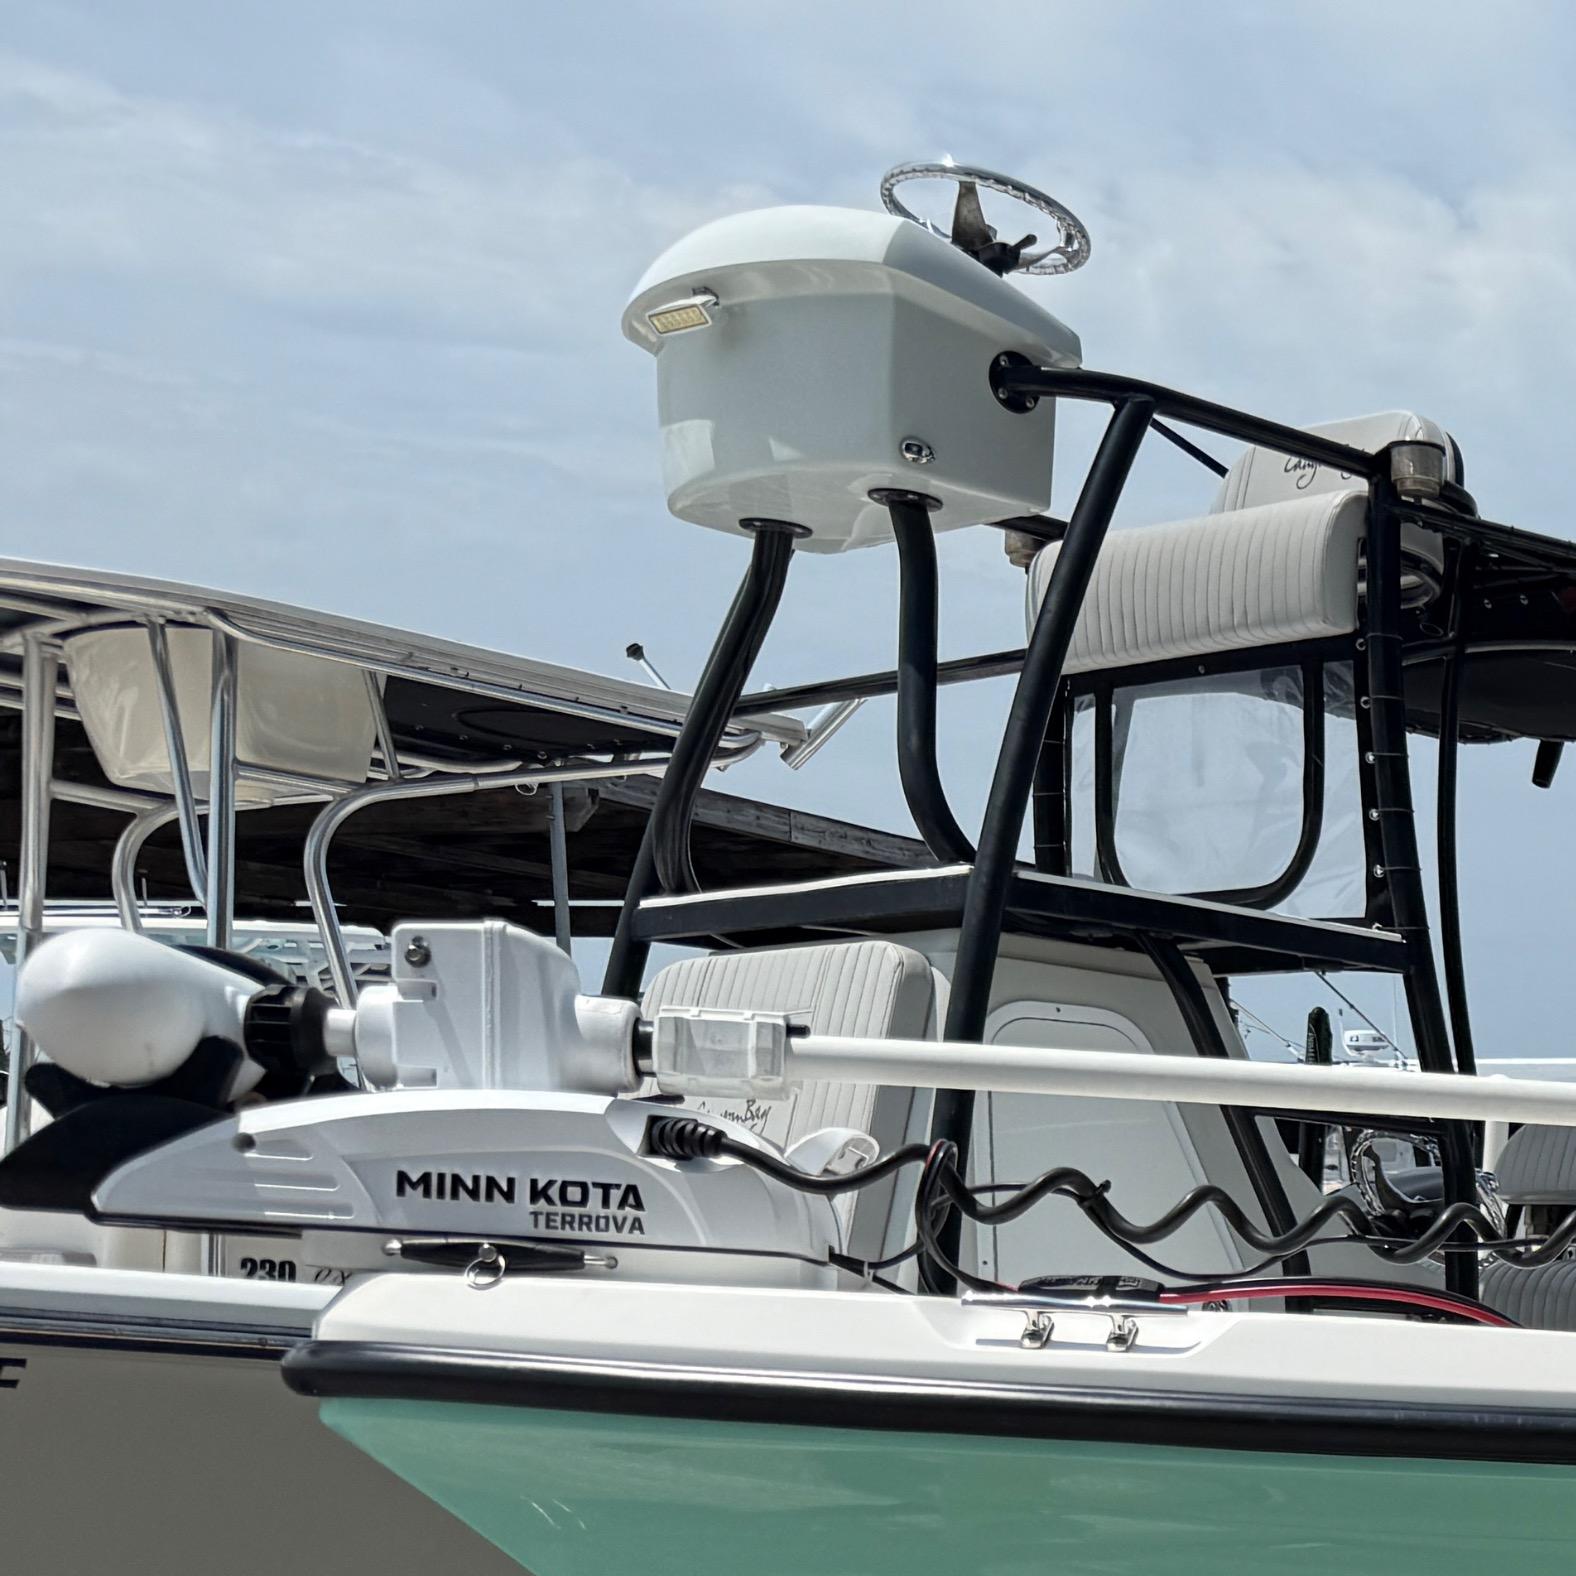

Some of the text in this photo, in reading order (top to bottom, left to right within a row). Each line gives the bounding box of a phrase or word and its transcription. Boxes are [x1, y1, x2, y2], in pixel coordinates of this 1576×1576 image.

[396, 1170, 646, 1212] MINN KOTA
[529, 1211, 646, 1235] TERROVA
